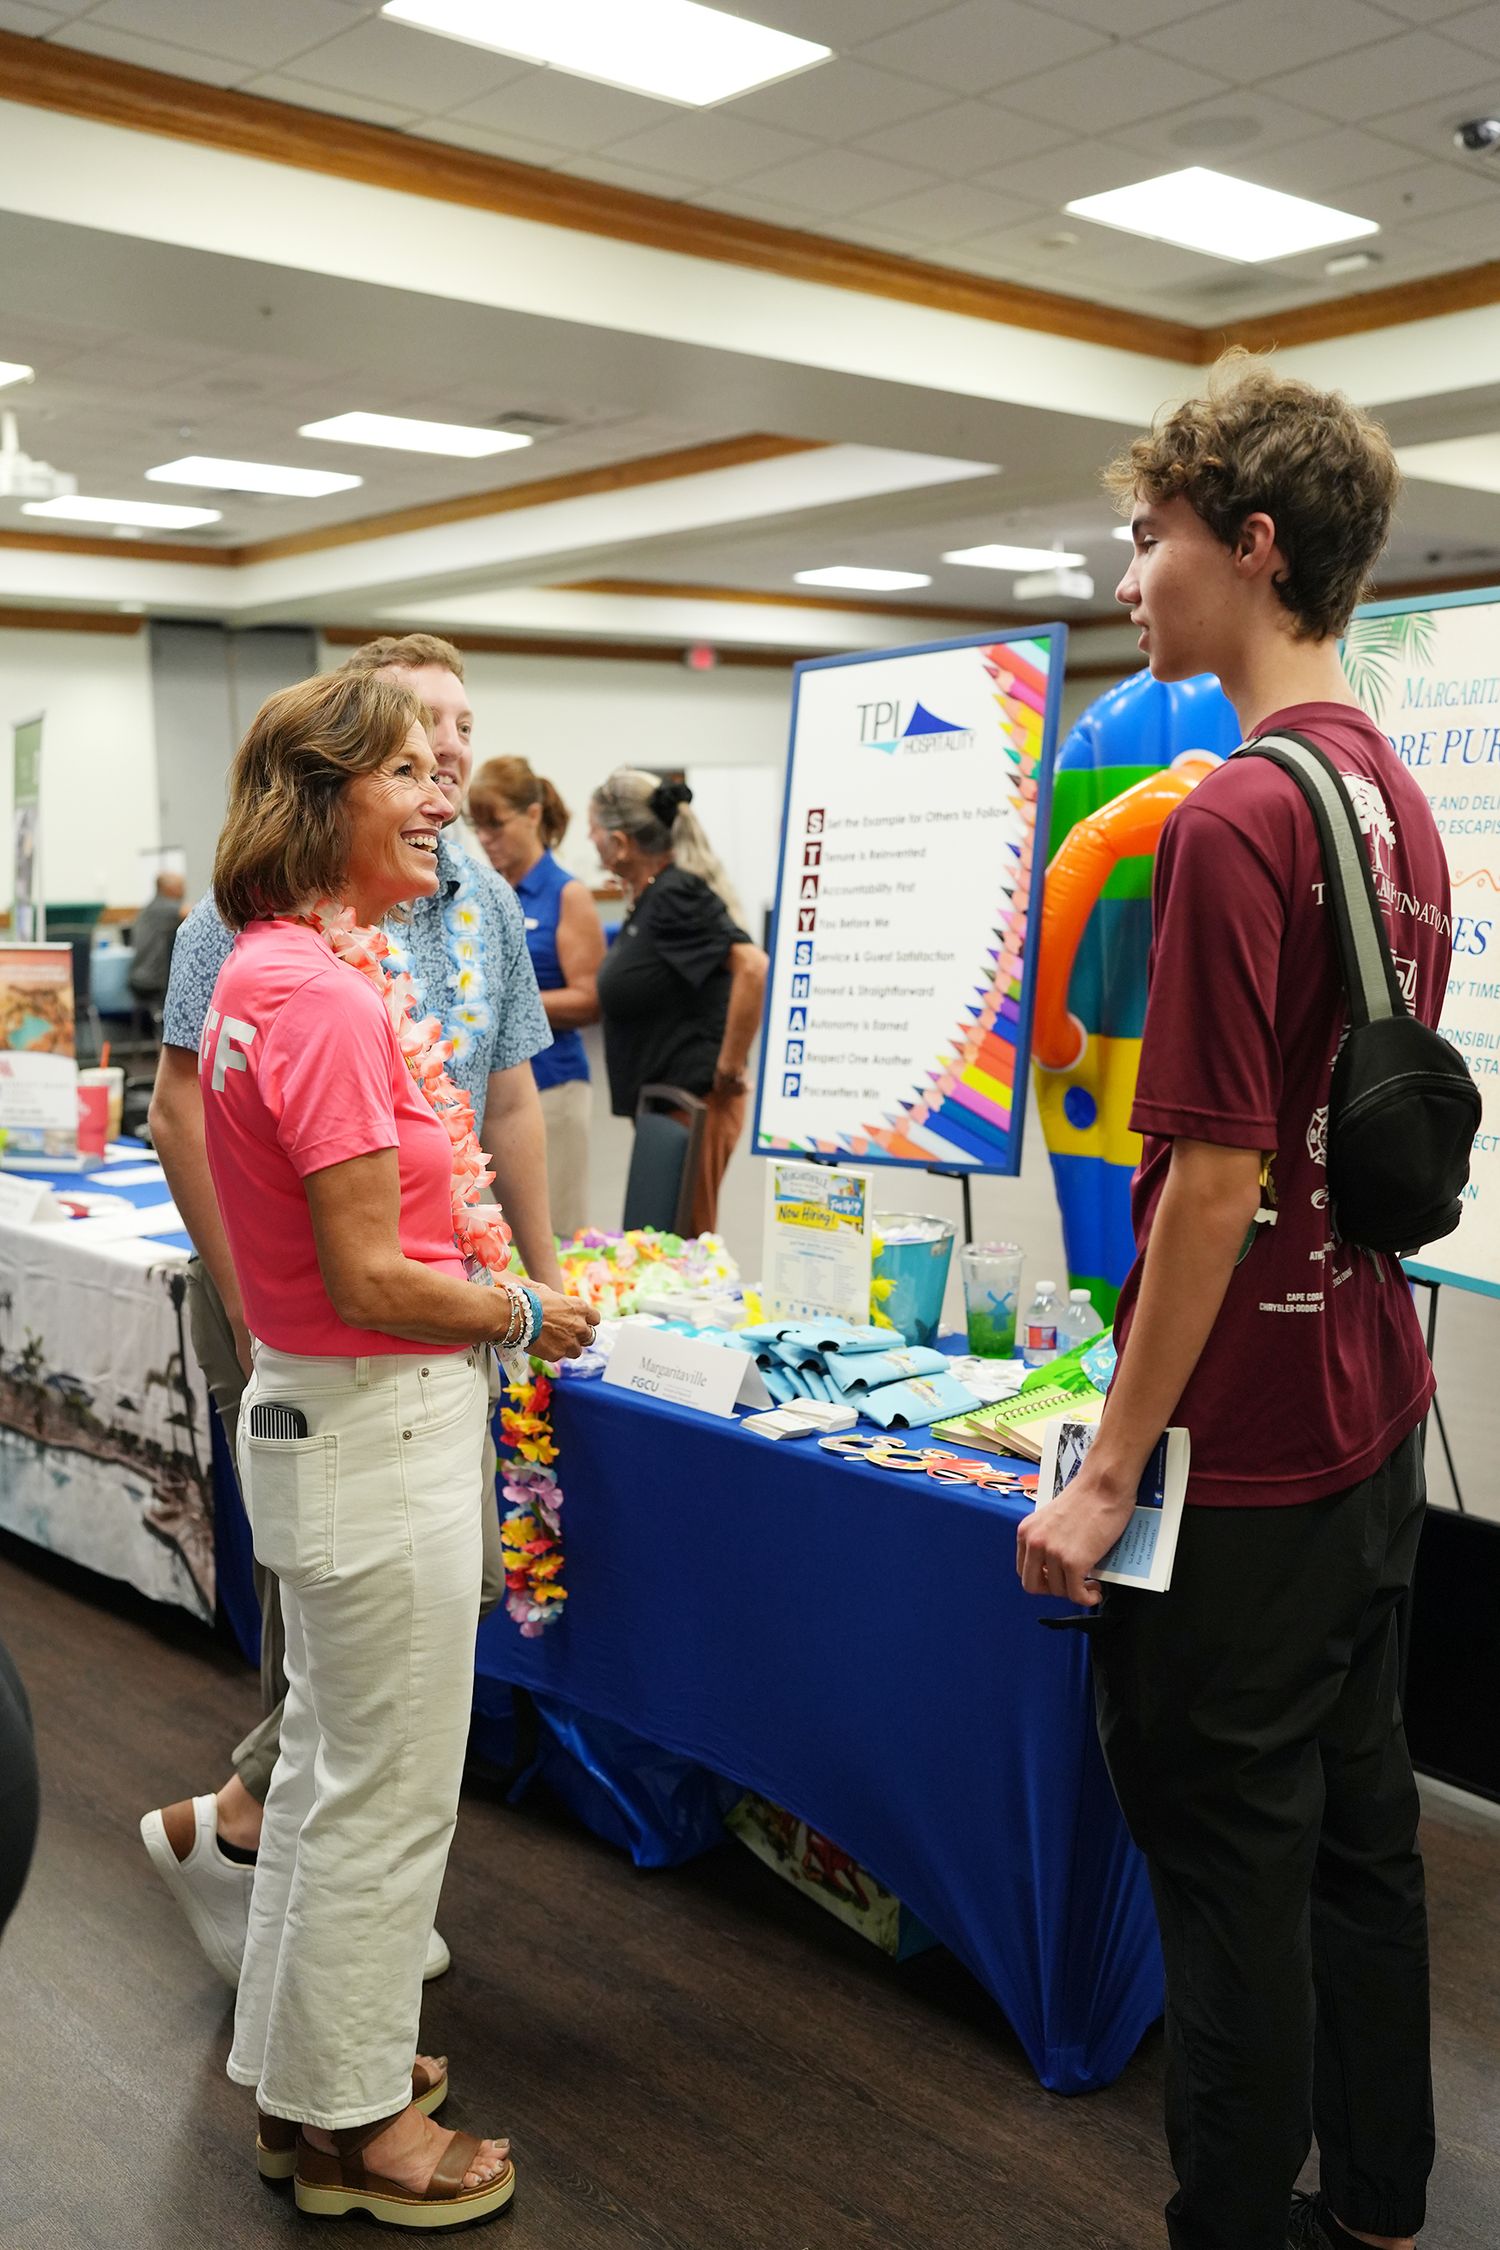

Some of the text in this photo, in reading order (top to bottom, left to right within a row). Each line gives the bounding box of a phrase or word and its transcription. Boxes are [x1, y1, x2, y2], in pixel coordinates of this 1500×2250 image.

[1401, 677, 1500, 709] MARGARIT
[857, 700, 901, 742] TPI
[1439, 796, 1469, 811] AND
[808, 813, 823, 833] S
[827, 819, 842, 829] Set
[845, 817, 859, 828] the
[862, 814, 906, 828] Example
[925, 810, 960, 823] Others
[962, 809, 973, 820] to
[976, 807, 1009, 819] Follow
[805, 843, 821, 865] T
[825, 852, 856, 863] Tenure
[869, 847, 927, 861] Reinvented
[801, 876, 819, 898] A
[822, 883, 893, 897] Accountability
[800, 910, 815, 932] Y
[819, 918, 836, 929] You
[840, 916, 870, 929] Before
[1452, 917, 1492, 955] ES
[796, 942, 812, 965] S
[815, 952, 850, 963] Service
[896, 949, 955, 962] Satisfaction
[793, 976, 809, 998] H
[813, 986, 846, 997] Honest
[858, 985, 935, 999] Straightforward
[1447, 980, 1466, 995] RY
[789, 1010, 806, 1031] A
[810, 1019, 859, 1032] Autonomy
[873, 1019, 908, 1031] Earned
[787, 1043, 912, 1066] R Respect One Another
[784, 1076, 800, 1097] P
[804, 1085, 858, 1098] Pacesetters
[1473, 1134, 1500, 1152] ECT
[777, 1204, 799, 1220] Now
[802, 1206, 836, 1227] Hiring!
[1286, 1292, 1305, 1302] CAPE
[639, 1356, 708, 1387] Margaritaville
[630, 1375, 660, 1393] FGCU
